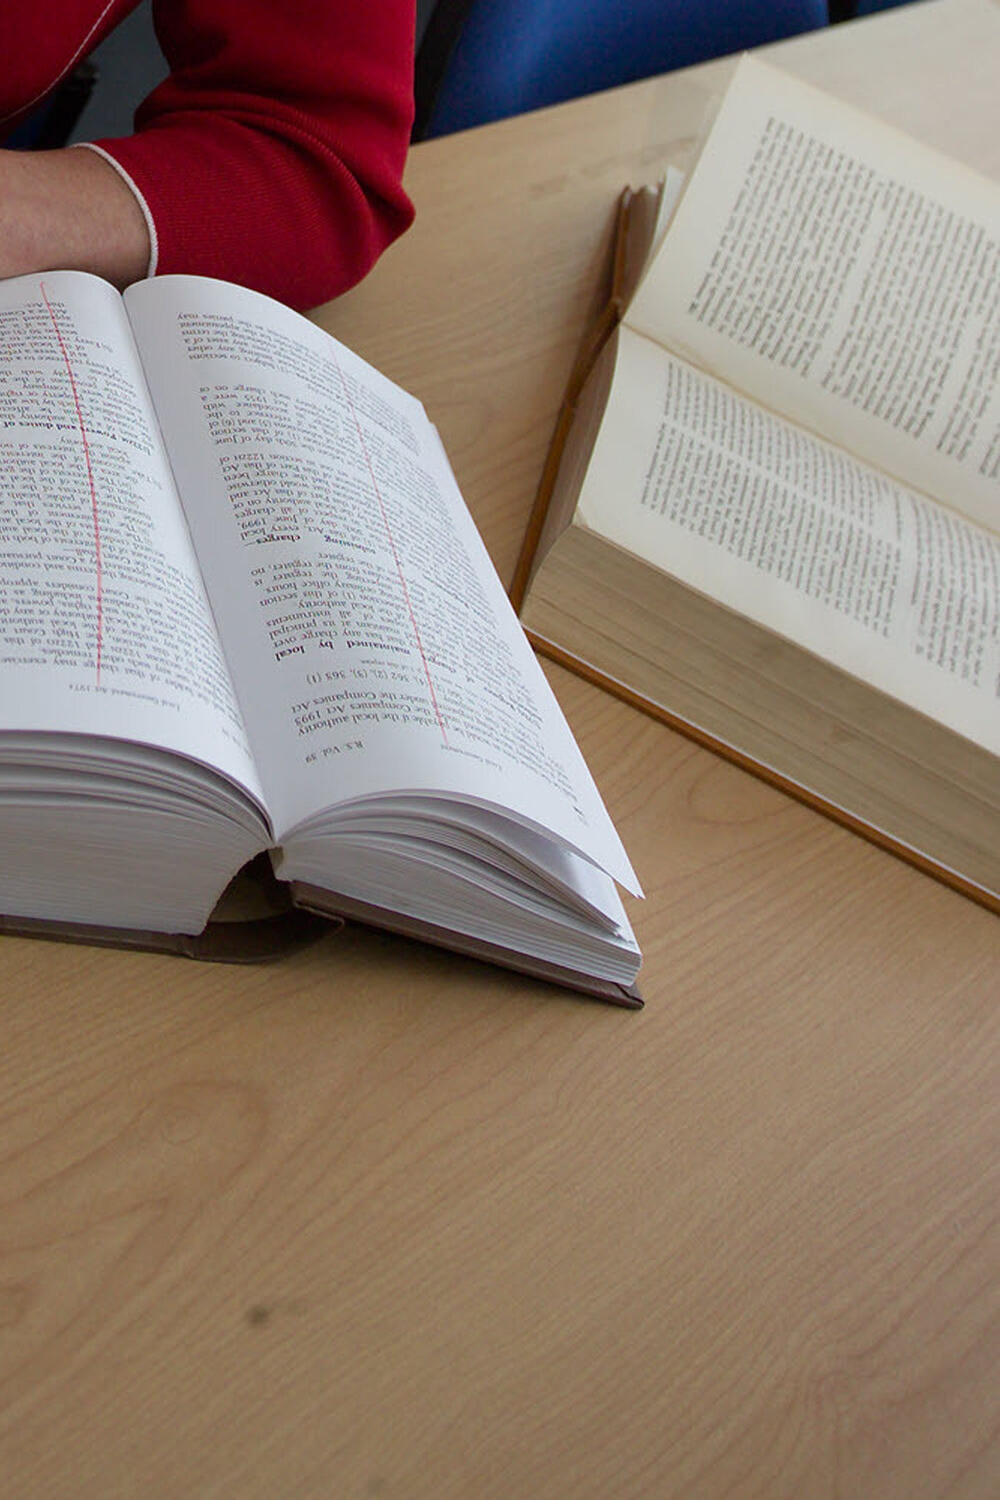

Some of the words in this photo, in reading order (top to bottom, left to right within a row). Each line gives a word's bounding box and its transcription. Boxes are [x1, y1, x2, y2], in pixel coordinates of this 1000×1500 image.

[260, 593, 298, 606] section
[274, 636, 296, 646] over
[302, 630, 338, 642] charge
[320, 640, 334, 649] by
[346, 641, 410, 654] maintained
[275, 646, 305, 661] local
[313, 692, 376, 707] Companies
[380, 692, 396, 704] the
[292, 702, 309, 713] Act
[327, 705, 345, 714] Act
[350, 701, 410, 712] Companies
[295, 710, 321, 725] 1993
[352, 714, 379, 724] local
[298, 716, 349, 735] authority
